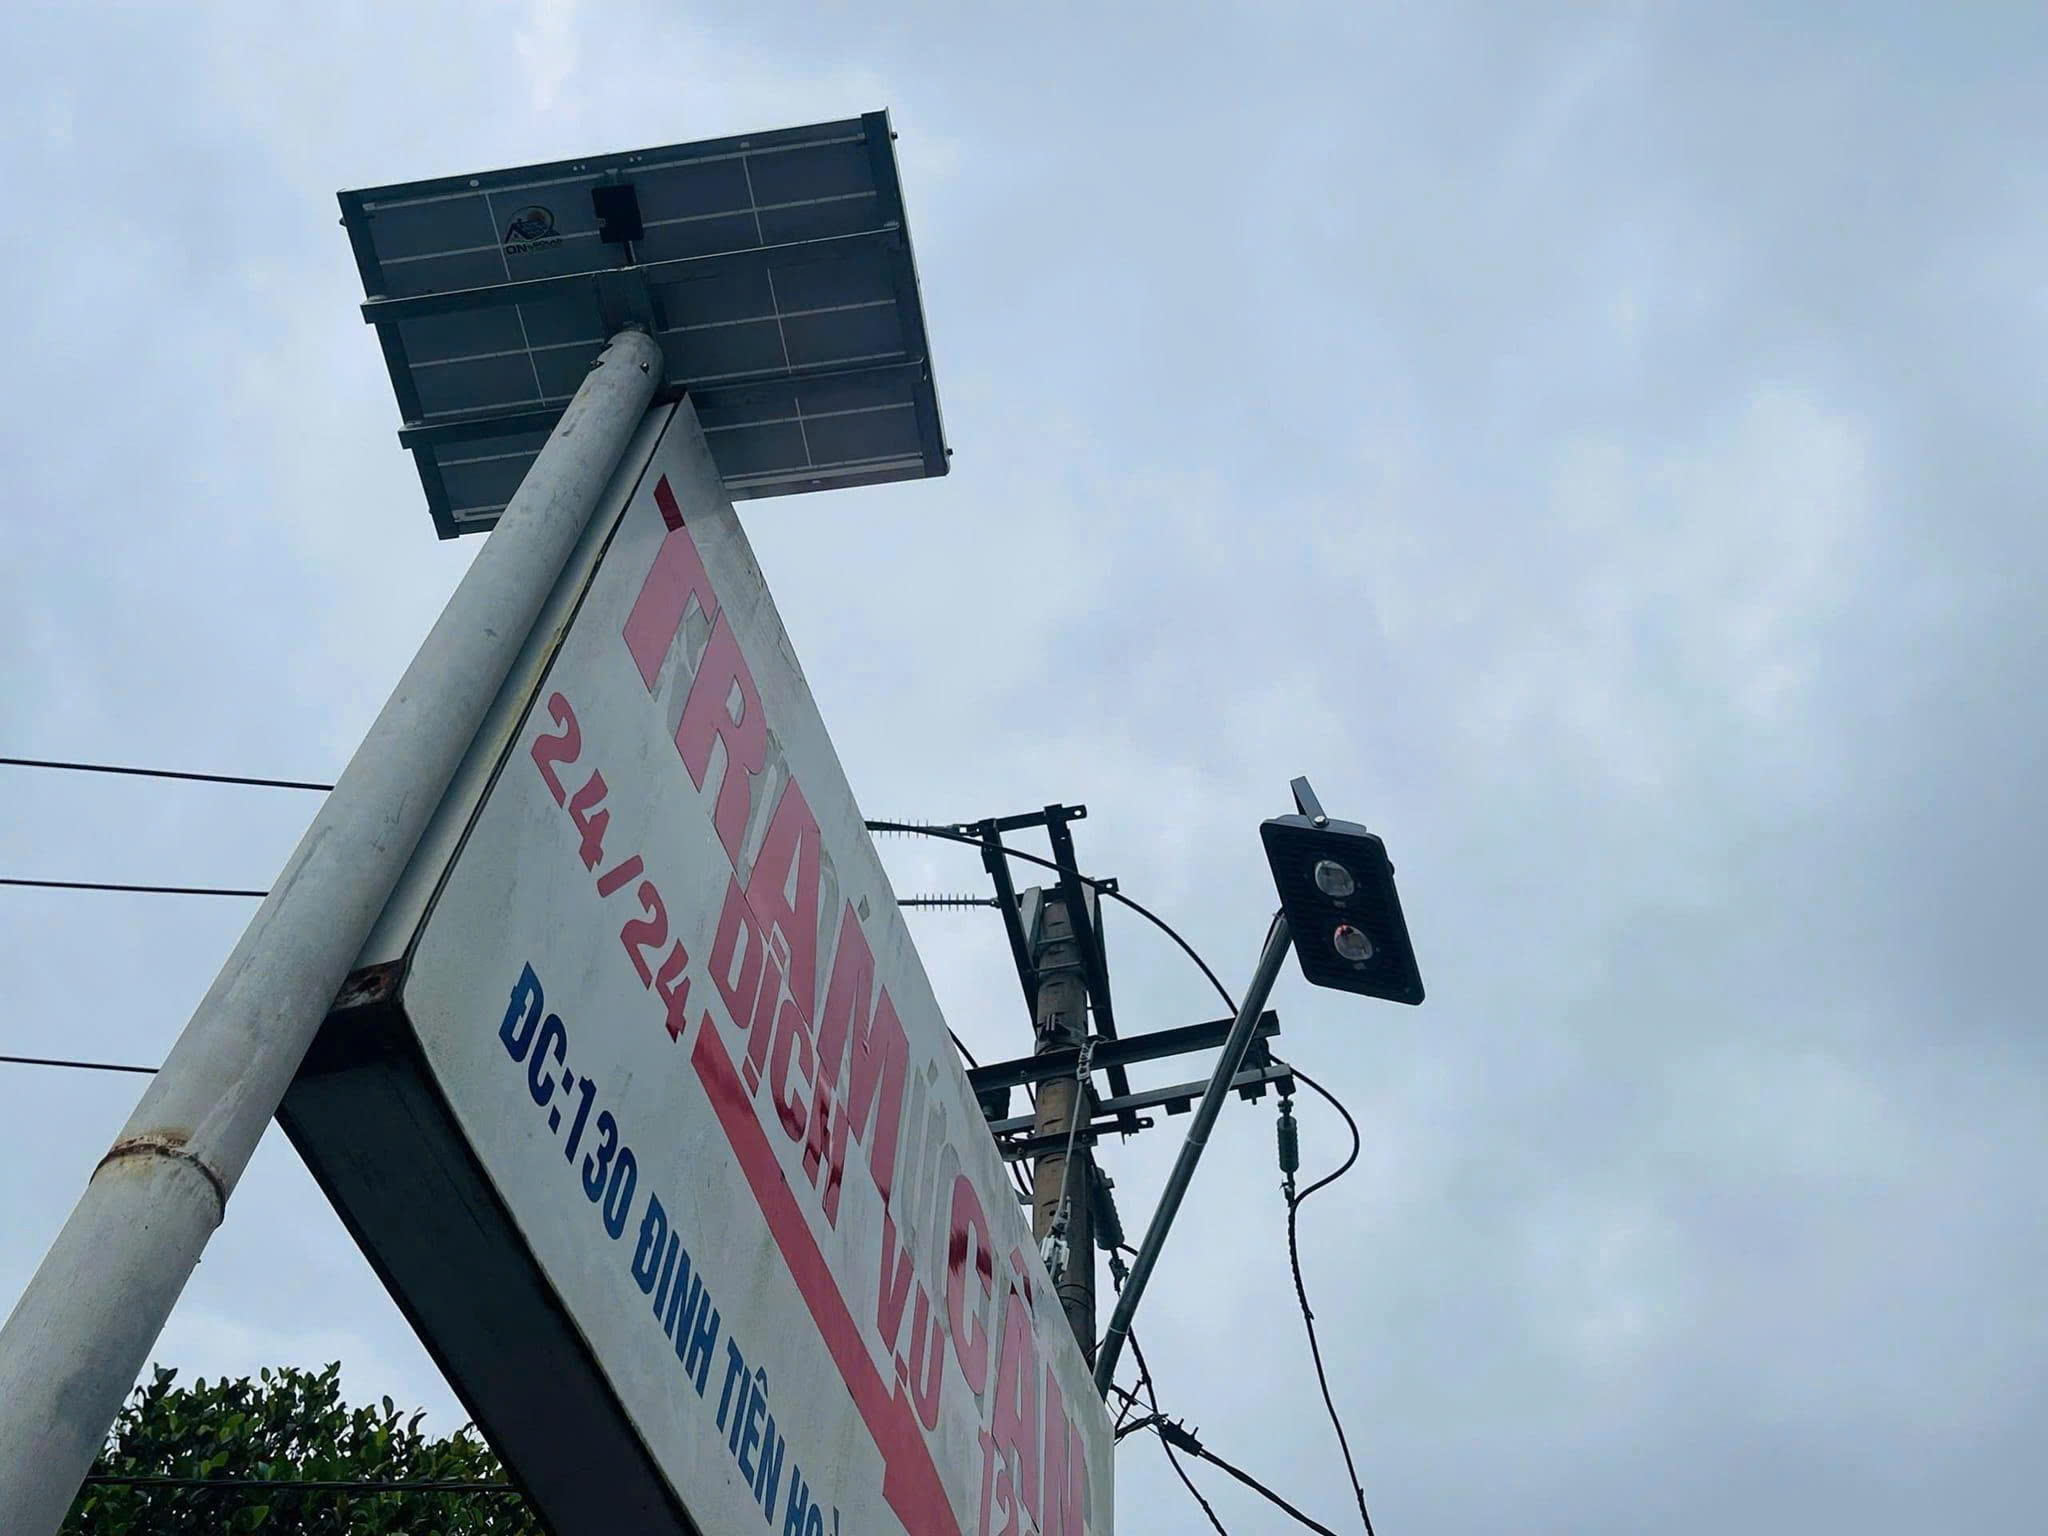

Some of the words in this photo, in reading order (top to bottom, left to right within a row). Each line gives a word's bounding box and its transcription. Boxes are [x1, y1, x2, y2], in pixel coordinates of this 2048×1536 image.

[531, 691, 692, 1044] 24/24
[623, 473, 910, 1206] TRẠM
[631, 1192, 720, 1399] ĐINH
[716, 1336, 785, 1527] TIÊN
[708, 872, 850, 1231] DỊCH
[877, 1205, 946, 1432] VỤ
